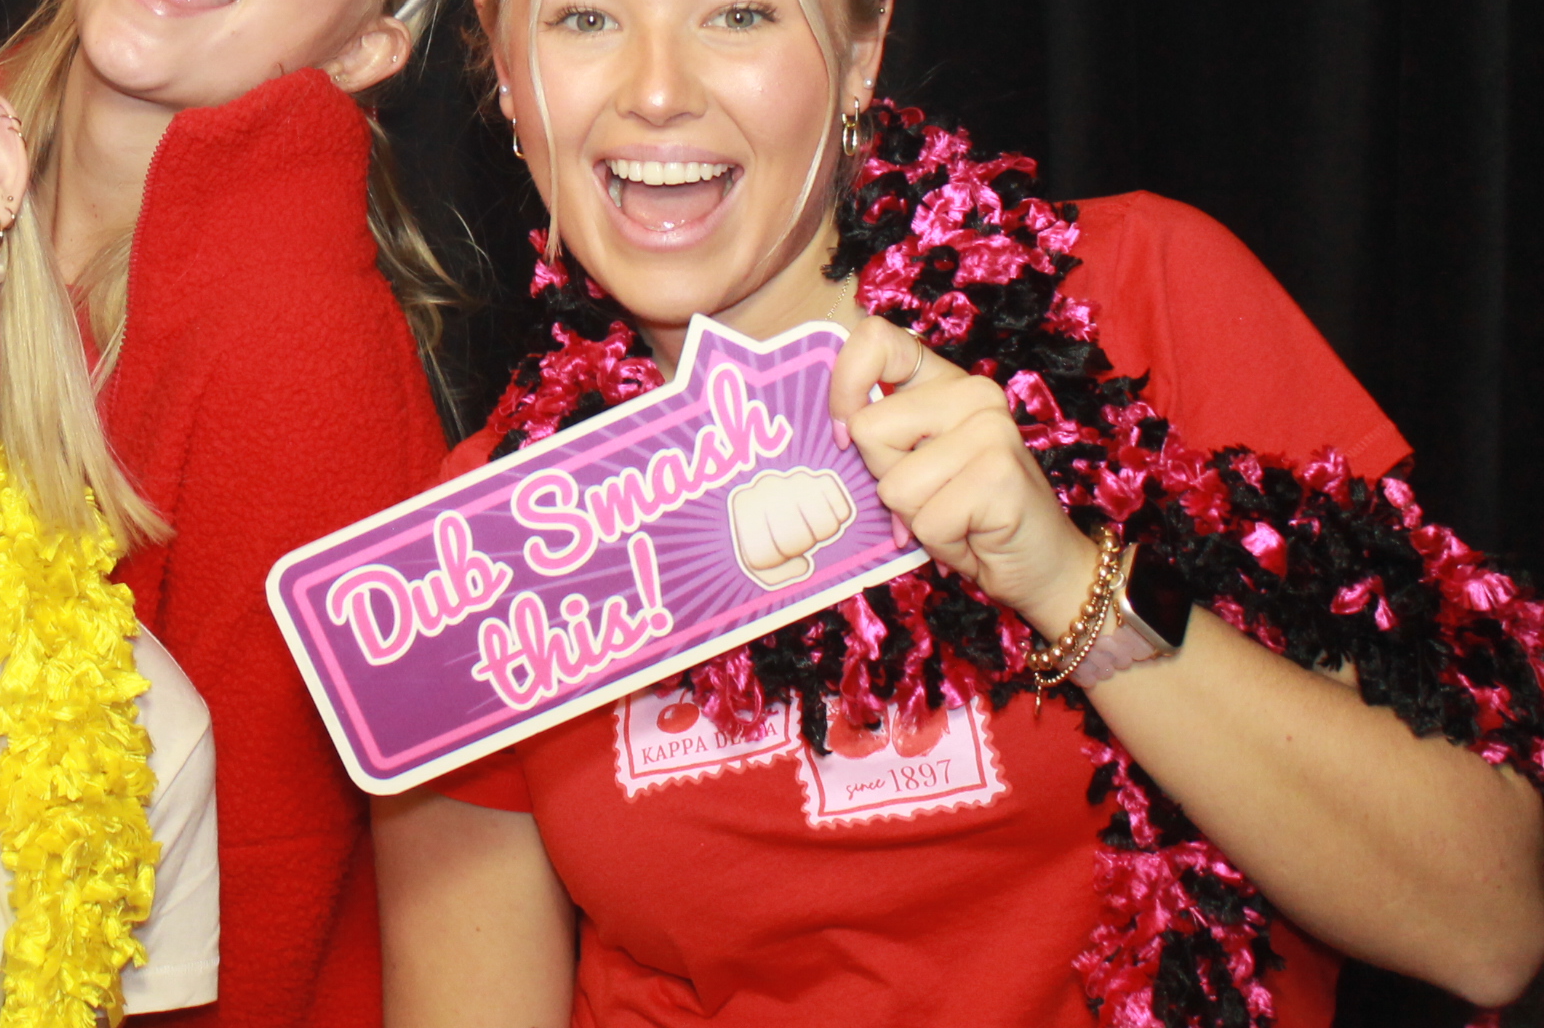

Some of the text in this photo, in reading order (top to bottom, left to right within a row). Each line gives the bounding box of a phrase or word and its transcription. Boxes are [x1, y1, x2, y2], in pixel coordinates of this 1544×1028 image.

[326, 362, 794, 666] Dub Smash
[472, 531, 673, 711] this!
[641, 738, 708, 766] KAPPA
[846, 758, 952, 801] since 1897
